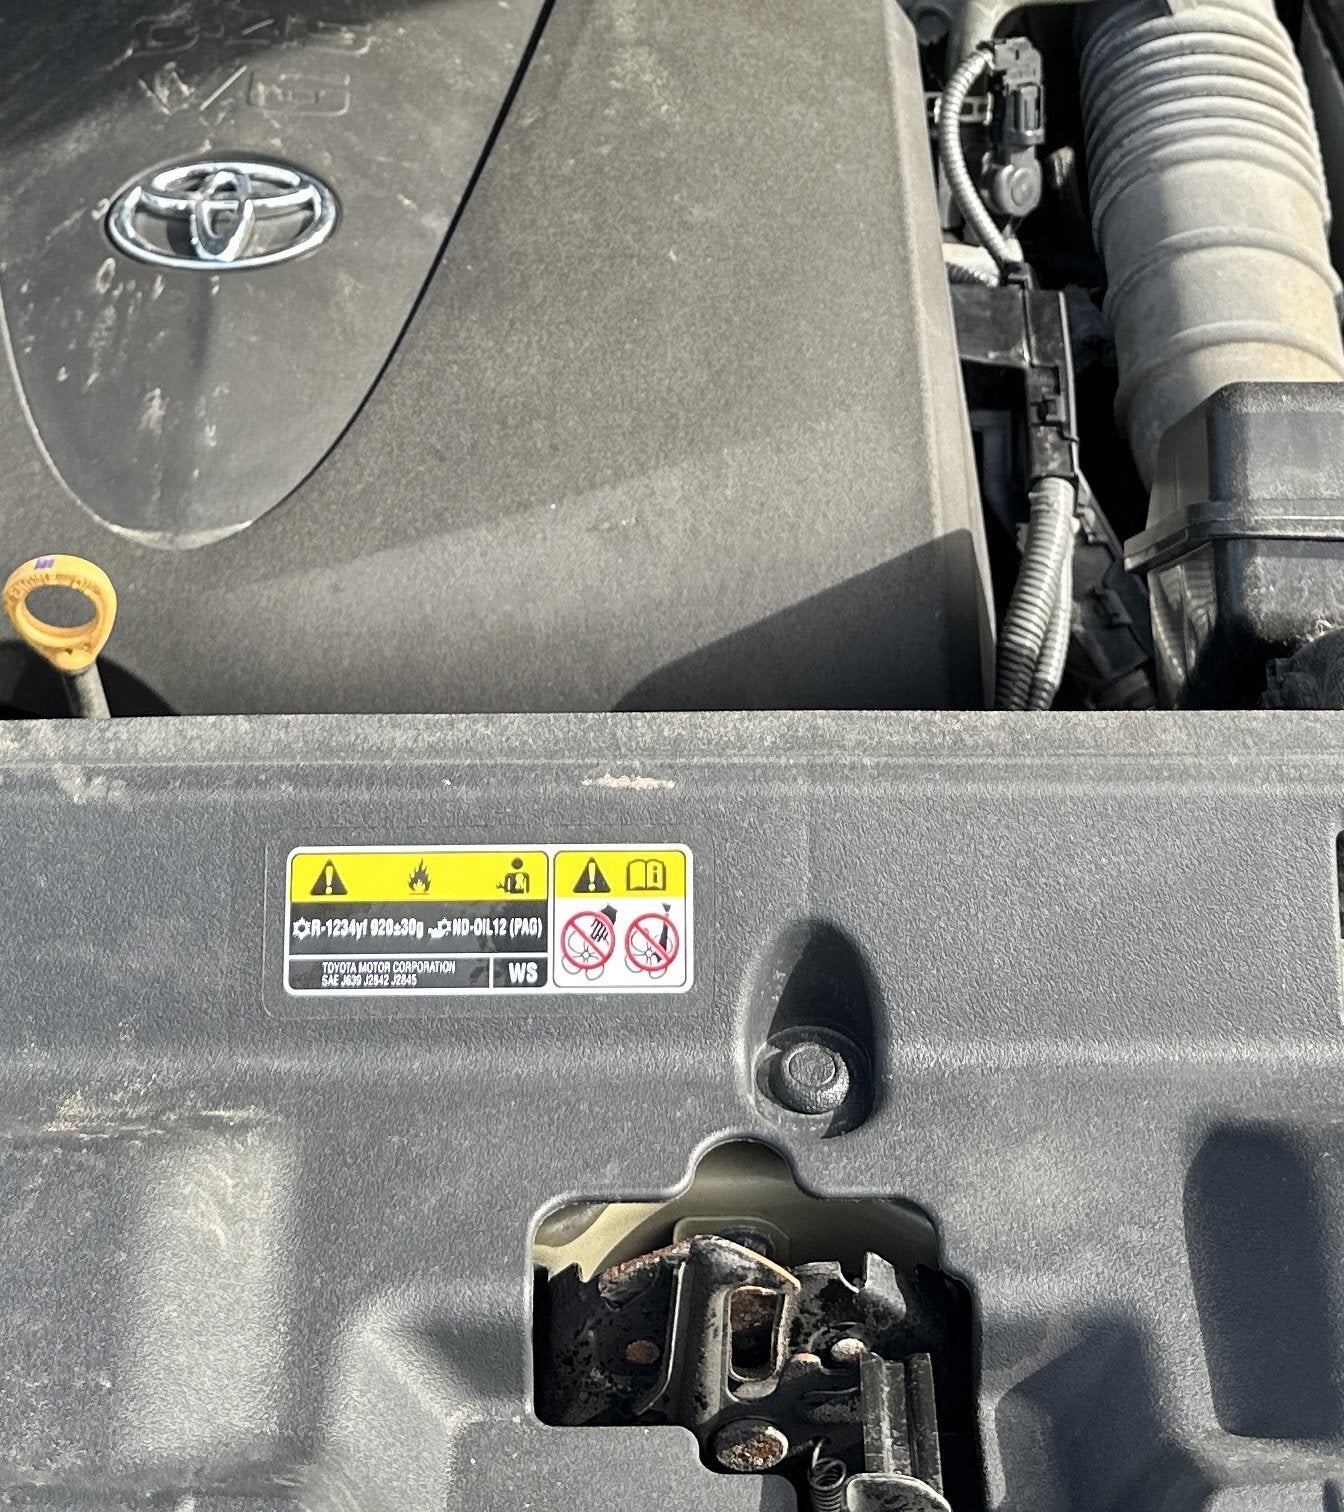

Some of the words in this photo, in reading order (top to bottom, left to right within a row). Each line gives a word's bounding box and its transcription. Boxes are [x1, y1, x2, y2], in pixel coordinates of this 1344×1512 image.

[509, 917, 543, 939] (PAG)
[321, 961, 358, 974] TOYOTA
[358, 960, 391, 974] MOTOR
[392, 960, 456, 974] CORPORATION
[508, 961, 538, 984] WS
[321, 974, 339, 987] SAE
[340, 974, 362, 986] J639
